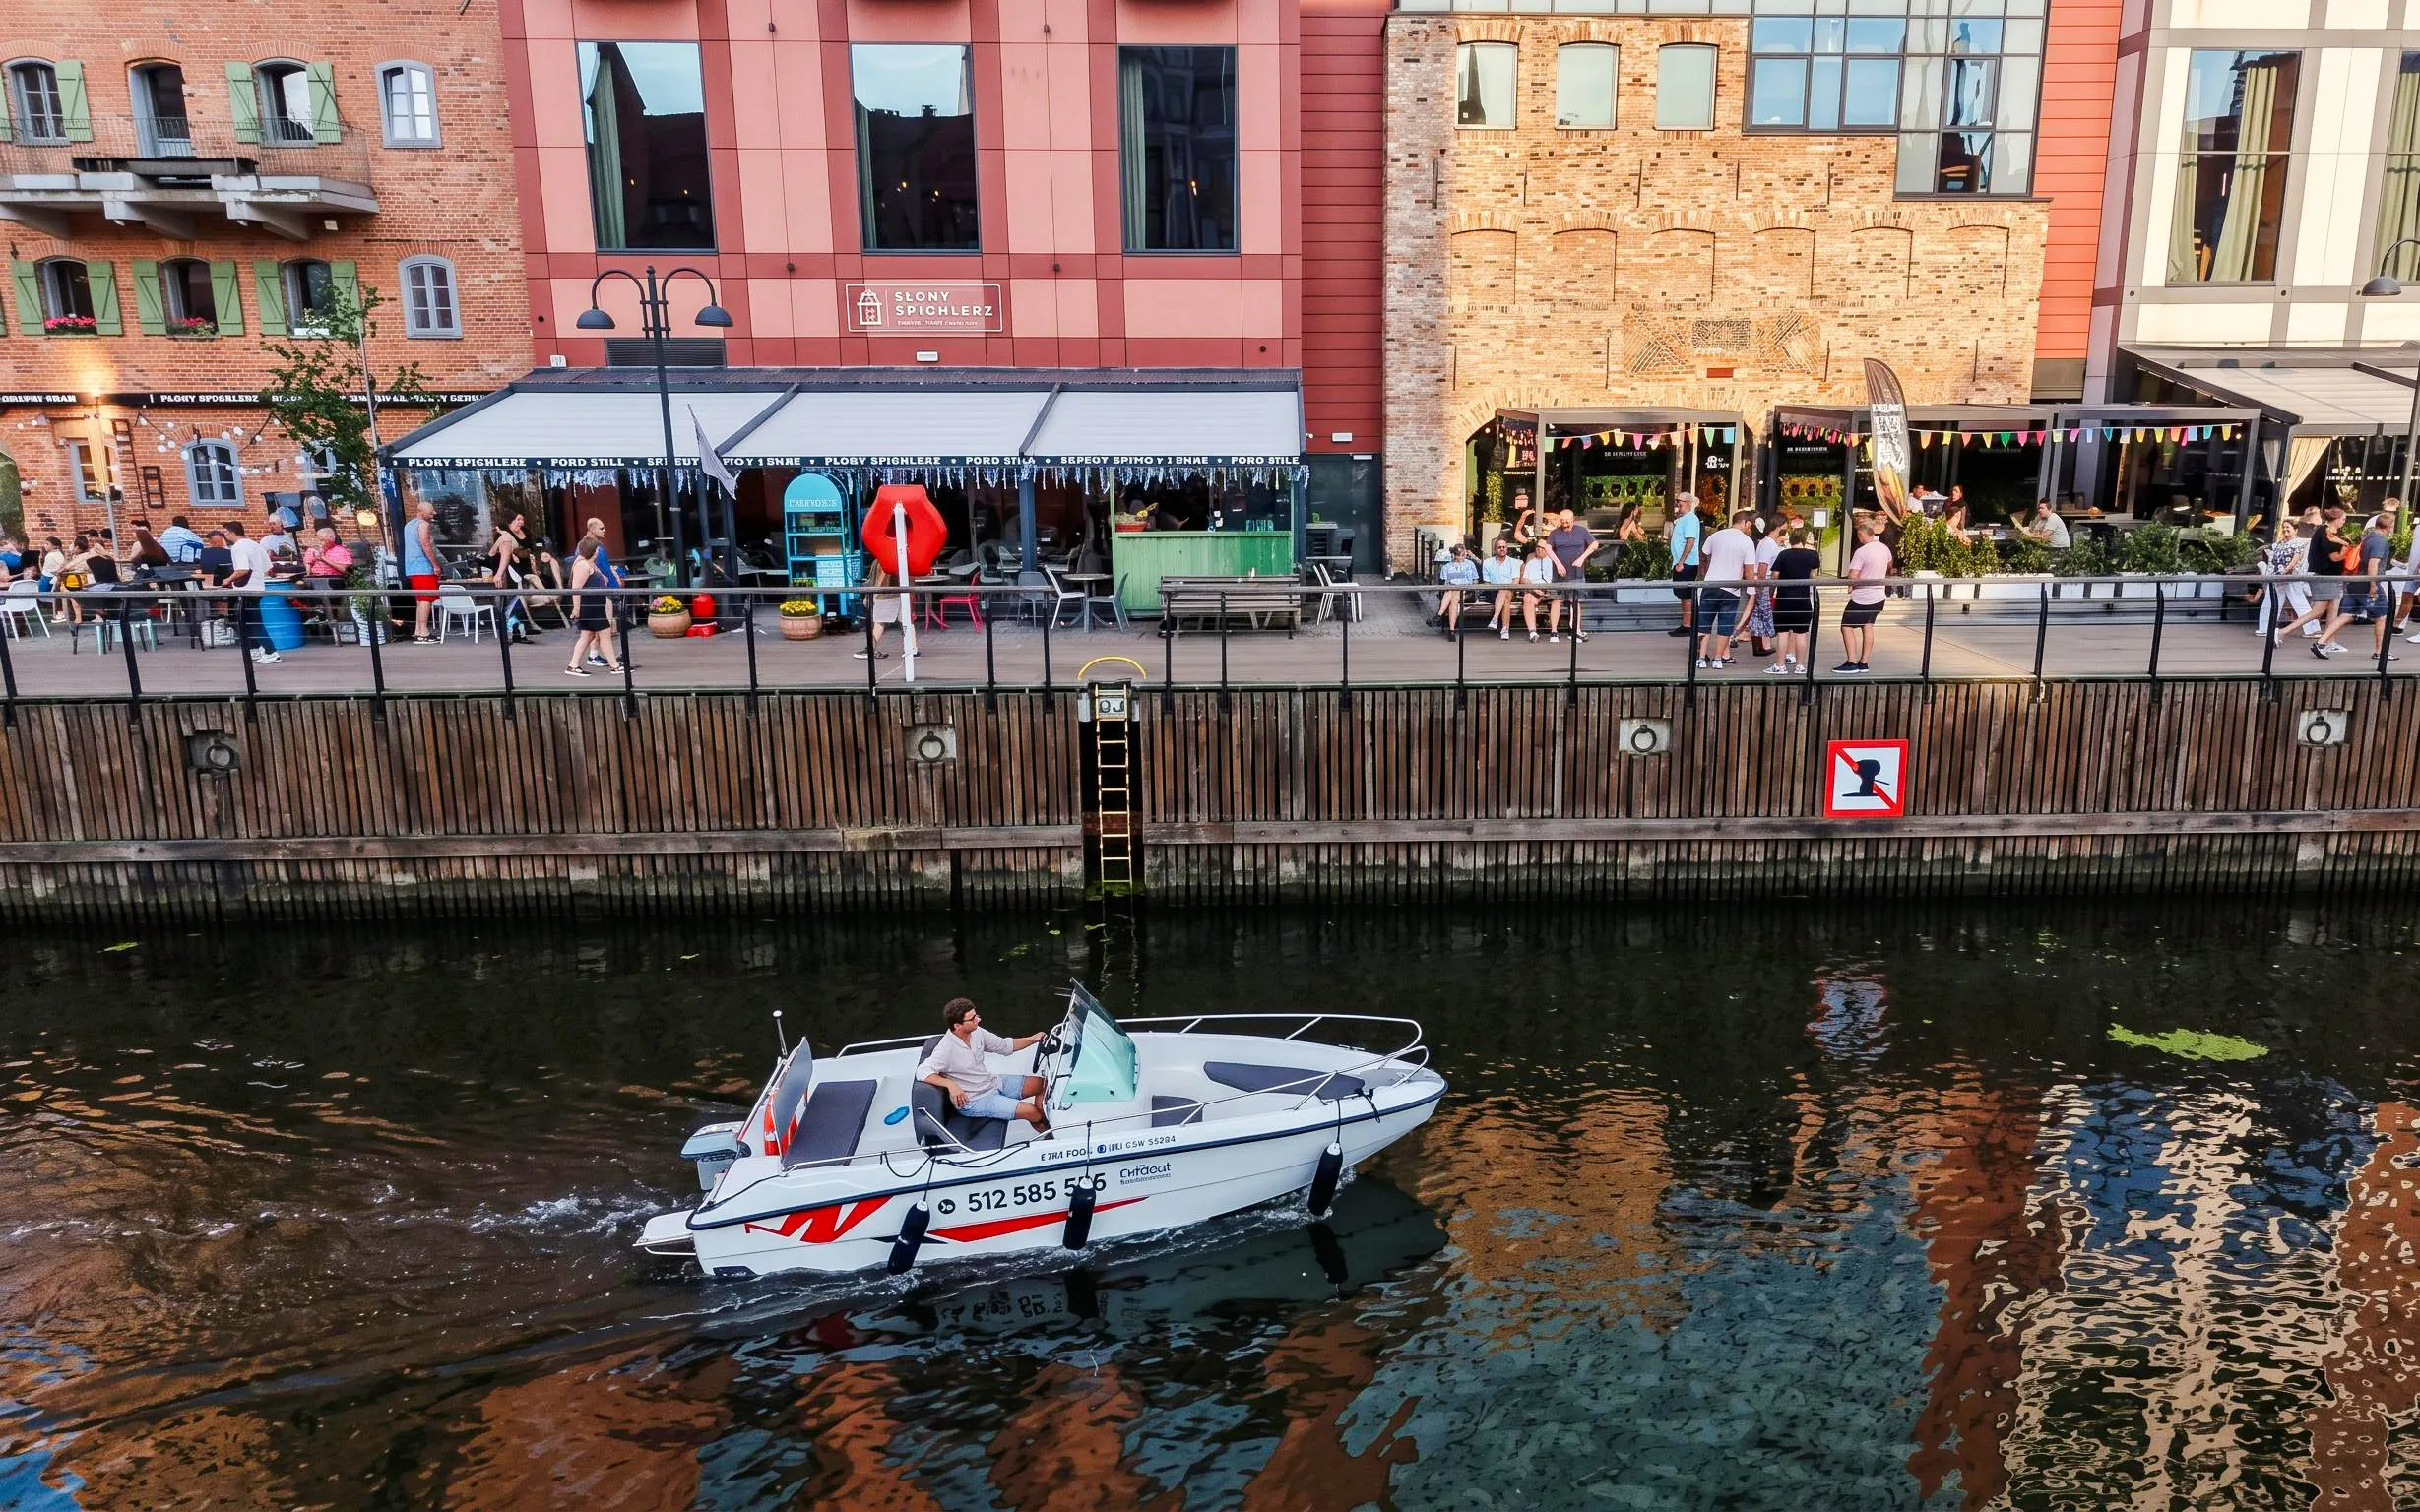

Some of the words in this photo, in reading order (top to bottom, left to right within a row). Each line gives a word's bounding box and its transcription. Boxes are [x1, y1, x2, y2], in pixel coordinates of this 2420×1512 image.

[894, 291, 950, 302] SŁONY
[895, 305, 993, 316] SPICHLERZ
[968, 1189, 1008, 1212] 512
[1013, 1181, 1057, 1206] 585
